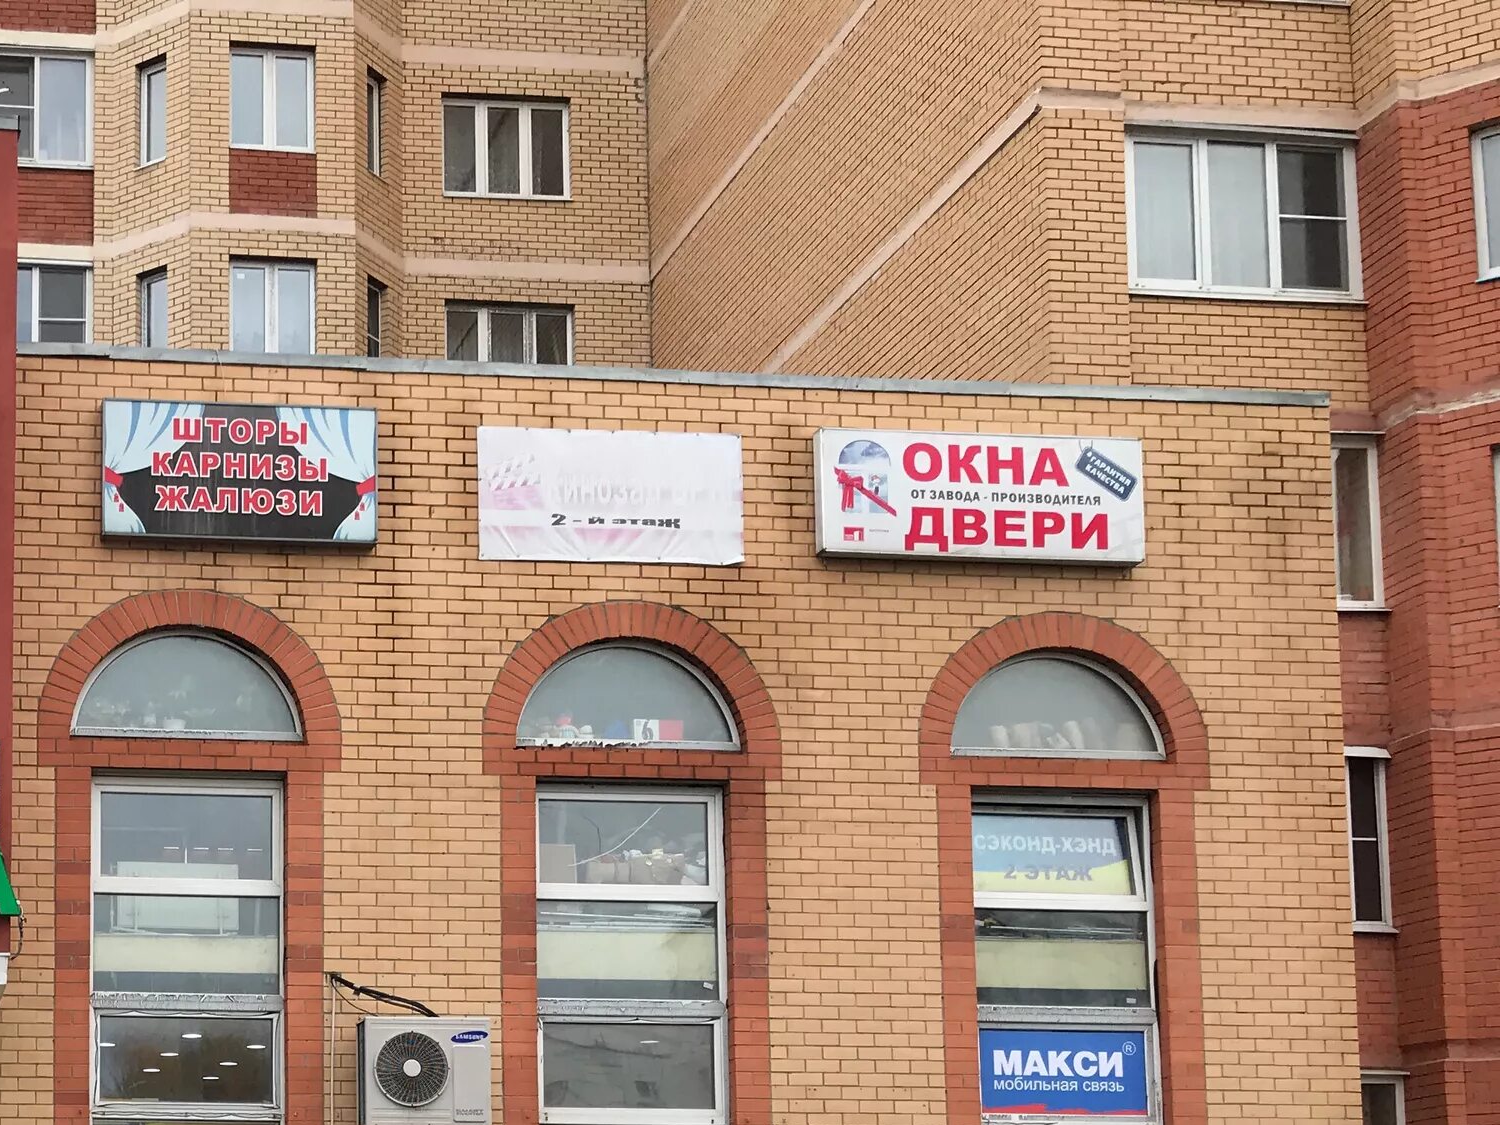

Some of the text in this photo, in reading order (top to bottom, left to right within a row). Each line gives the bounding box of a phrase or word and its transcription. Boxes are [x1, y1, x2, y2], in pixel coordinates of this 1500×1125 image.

[173, 417, 308, 446] ШТОРЫ
[151, 451, 329, 482] КАРНИЗЫ
[902, 442, 1069, 487] ОКНА
[1085, 463, 1125, 494] КАЧЕСТВА
[1089, 456, 1132, 487] ГАРАНТИЯ
[155, 485, 323, 516] ЖАЛЮЗИ
[911, 489, 926, 500] ОТ
[929, 489, 980, 502] ЗАВОДА
[991, 492, 1101, 506] ПРОИЗВОДИТЕЛЯ
[551, 513, 567, 526] 2
[612, 518, 681, 529] этаж
[904, 506, 1109, 552] ДВЕРИ
[974, 834, 1117, 857] СЭКОНД-ХЭНД
[1003, 865, 1093, 881] 2 ЭТАЖ
[993, 1049, 1124, 1078] МАКСИ
[993, 1077, 1125, 1092] мобильная связь
